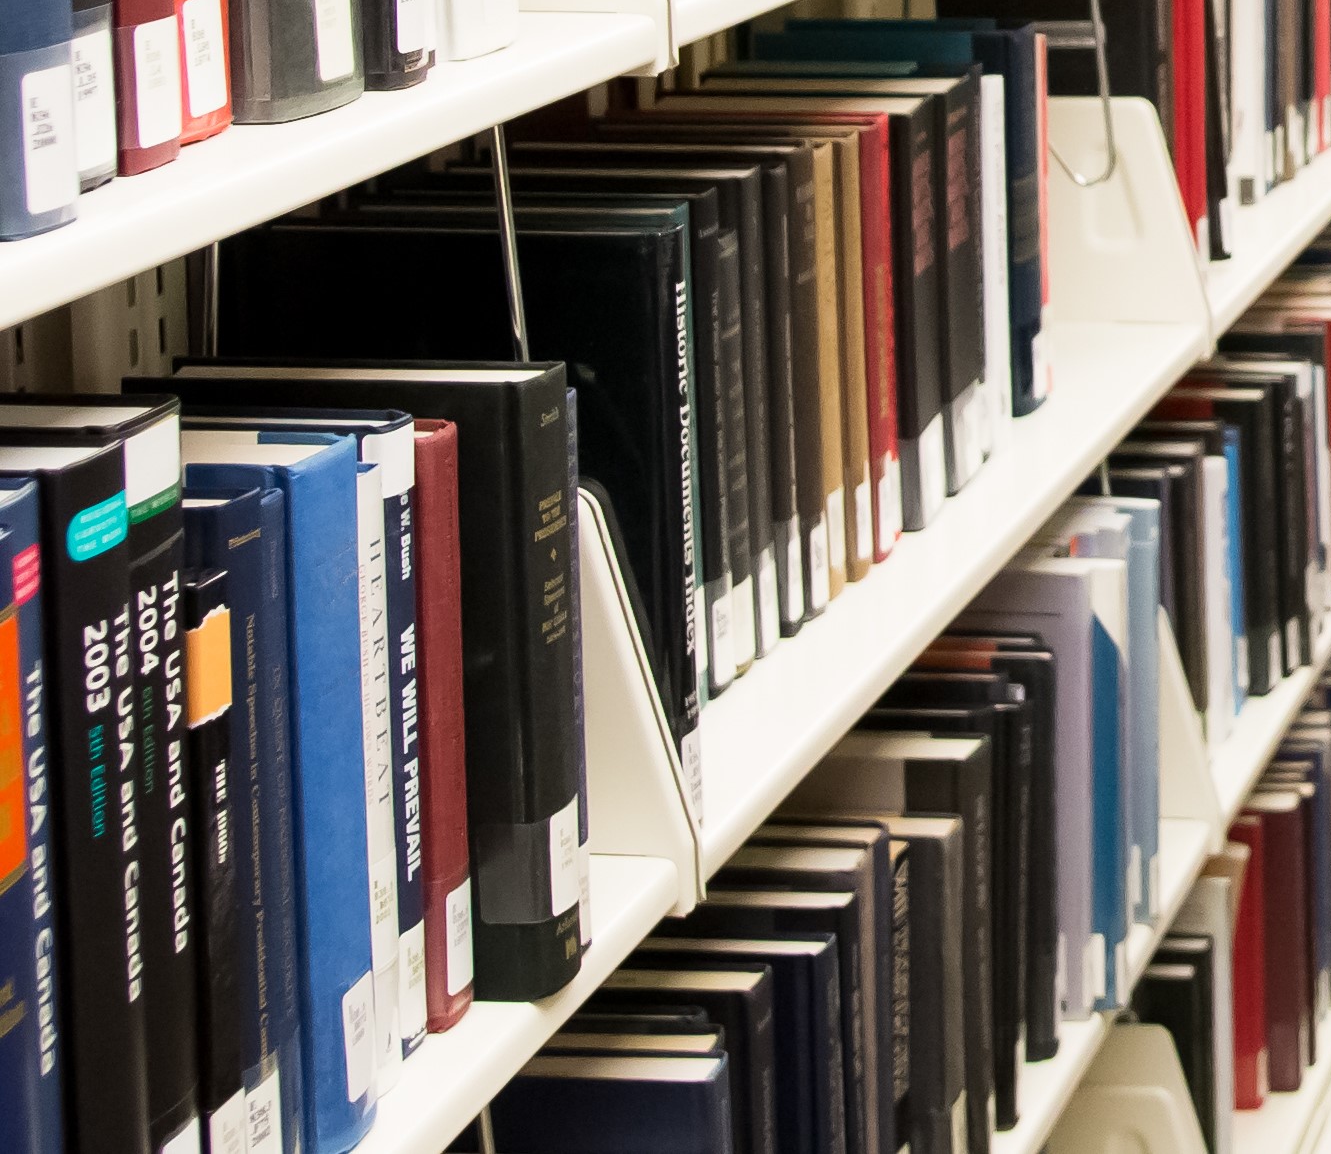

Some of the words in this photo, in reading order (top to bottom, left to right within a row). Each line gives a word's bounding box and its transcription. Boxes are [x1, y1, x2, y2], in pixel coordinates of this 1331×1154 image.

[400, 507, 412, 532] W.
[400, 532, 413, 581] Bush
[114, 601, 131, 679] The
[138, 584, 160, 676] 2004
[162, 569, 180, 643] The
[83, 617, 112, 715] 2003
[164, 648, 182, 732] USA
[370, 538, 391, 804] HEARTBEAT
[400, 622, 417, 676] WE
[26, 658, 44, 740] The
[117, 685, 136, 773] USA
[401, 677, 419, 755] WILL
[27, 745, 47, 837] USA
[167, 739, 186, 809] and
[213, 757, 228, 804] THE
[119, 778, 139, 853] and
[402, 756, 422, 883] PREVAIL
[30, 842, 51, 920] and
[169, 816, 191, 955] Canada
[122, 859, 145, 1004] Canada
[34, 925, 58, 1078] Canada
